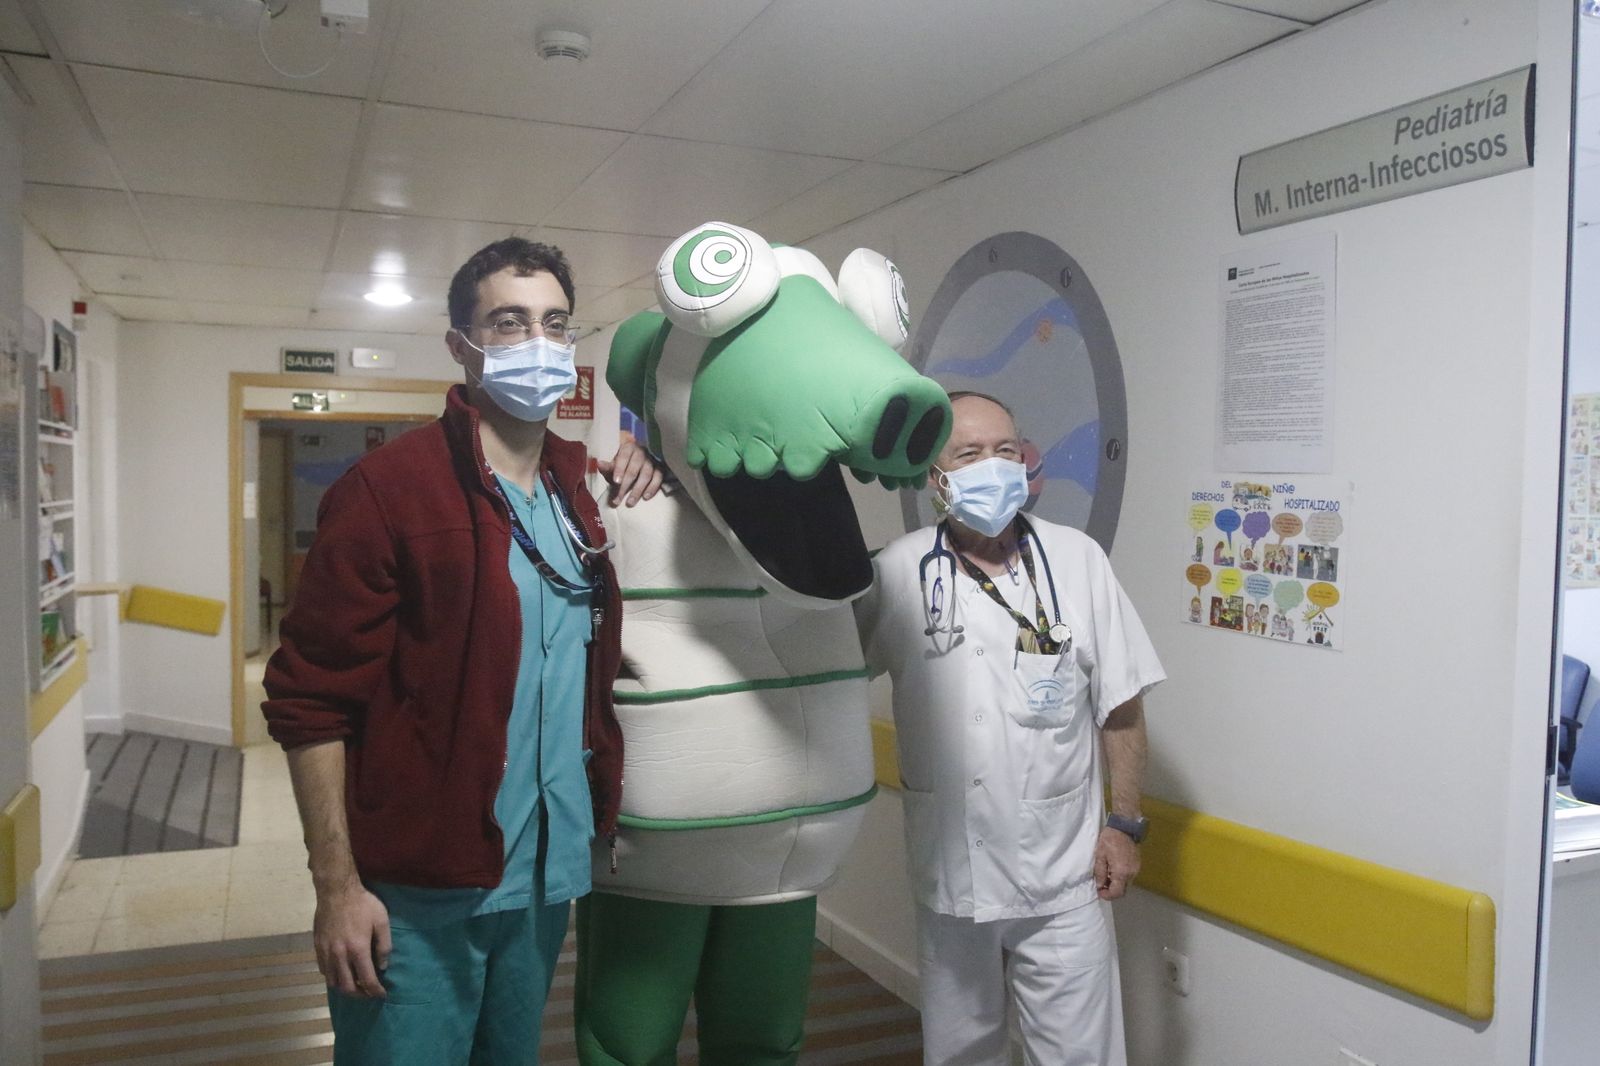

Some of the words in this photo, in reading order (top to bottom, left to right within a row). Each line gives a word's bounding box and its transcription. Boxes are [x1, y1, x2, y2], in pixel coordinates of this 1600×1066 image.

[1394, 89, 1508, 145] Pediatría
[1254, 192, 1279, 217] M.
[1287, 133, 1508, 210] Interna-Infecciosos
[286, 355, 333, 367] SALIDA
[1221, 480, 1232, 489] DEL
[1272, 483, 1295, 494] NIÑ@
[1191, 491, 1225, 502] DERECHOS
[1285, 498, 1340, 512] HOSPITALIZADO
